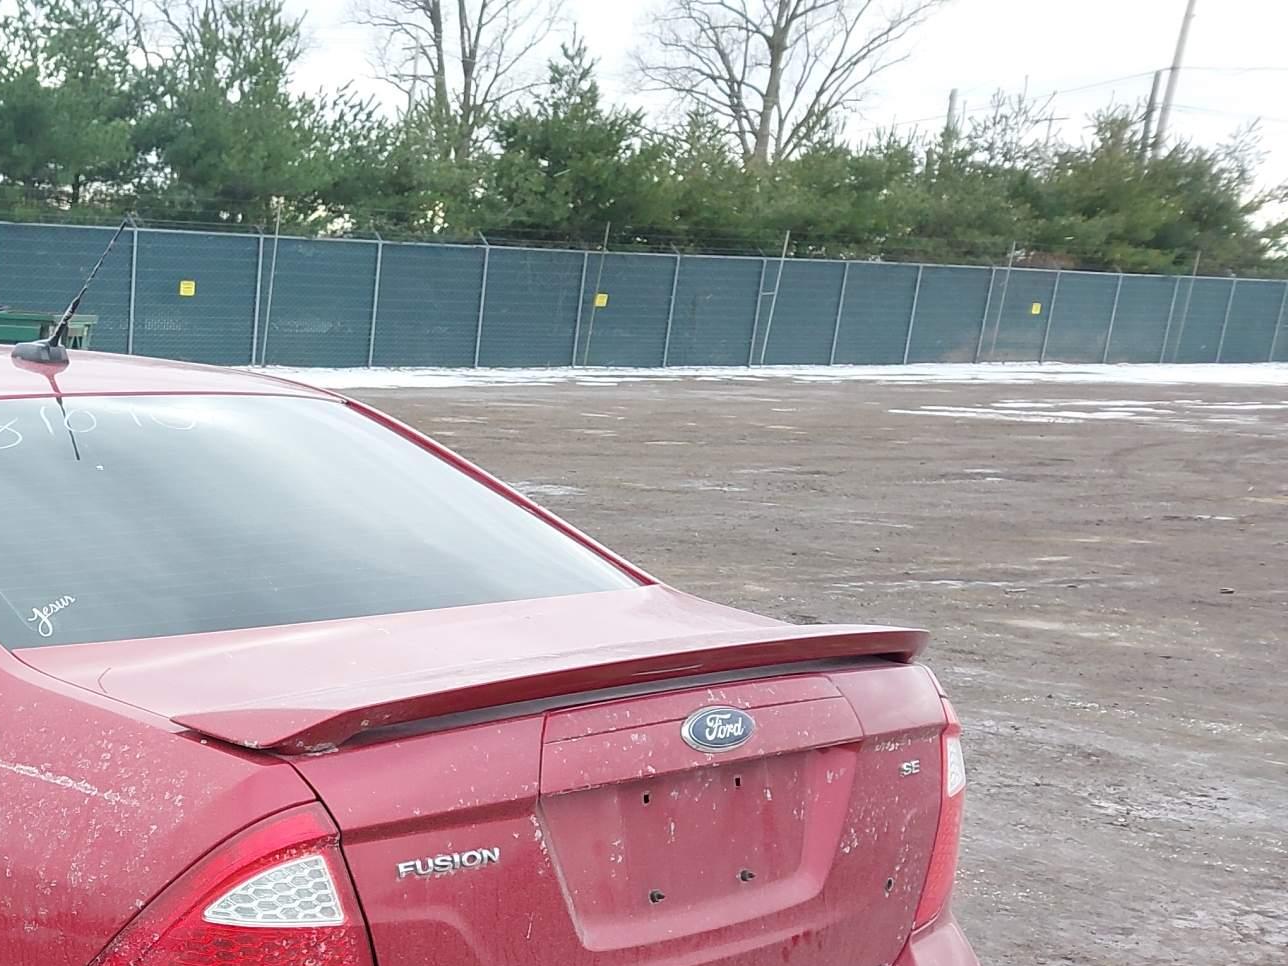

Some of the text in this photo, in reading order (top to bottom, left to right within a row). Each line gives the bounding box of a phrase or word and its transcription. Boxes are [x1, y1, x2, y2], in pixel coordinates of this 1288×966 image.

[705, 713, 745, 741] Ford
[902, 760, 921, 776] SE
[398, 847, 500, 878] FUSION
